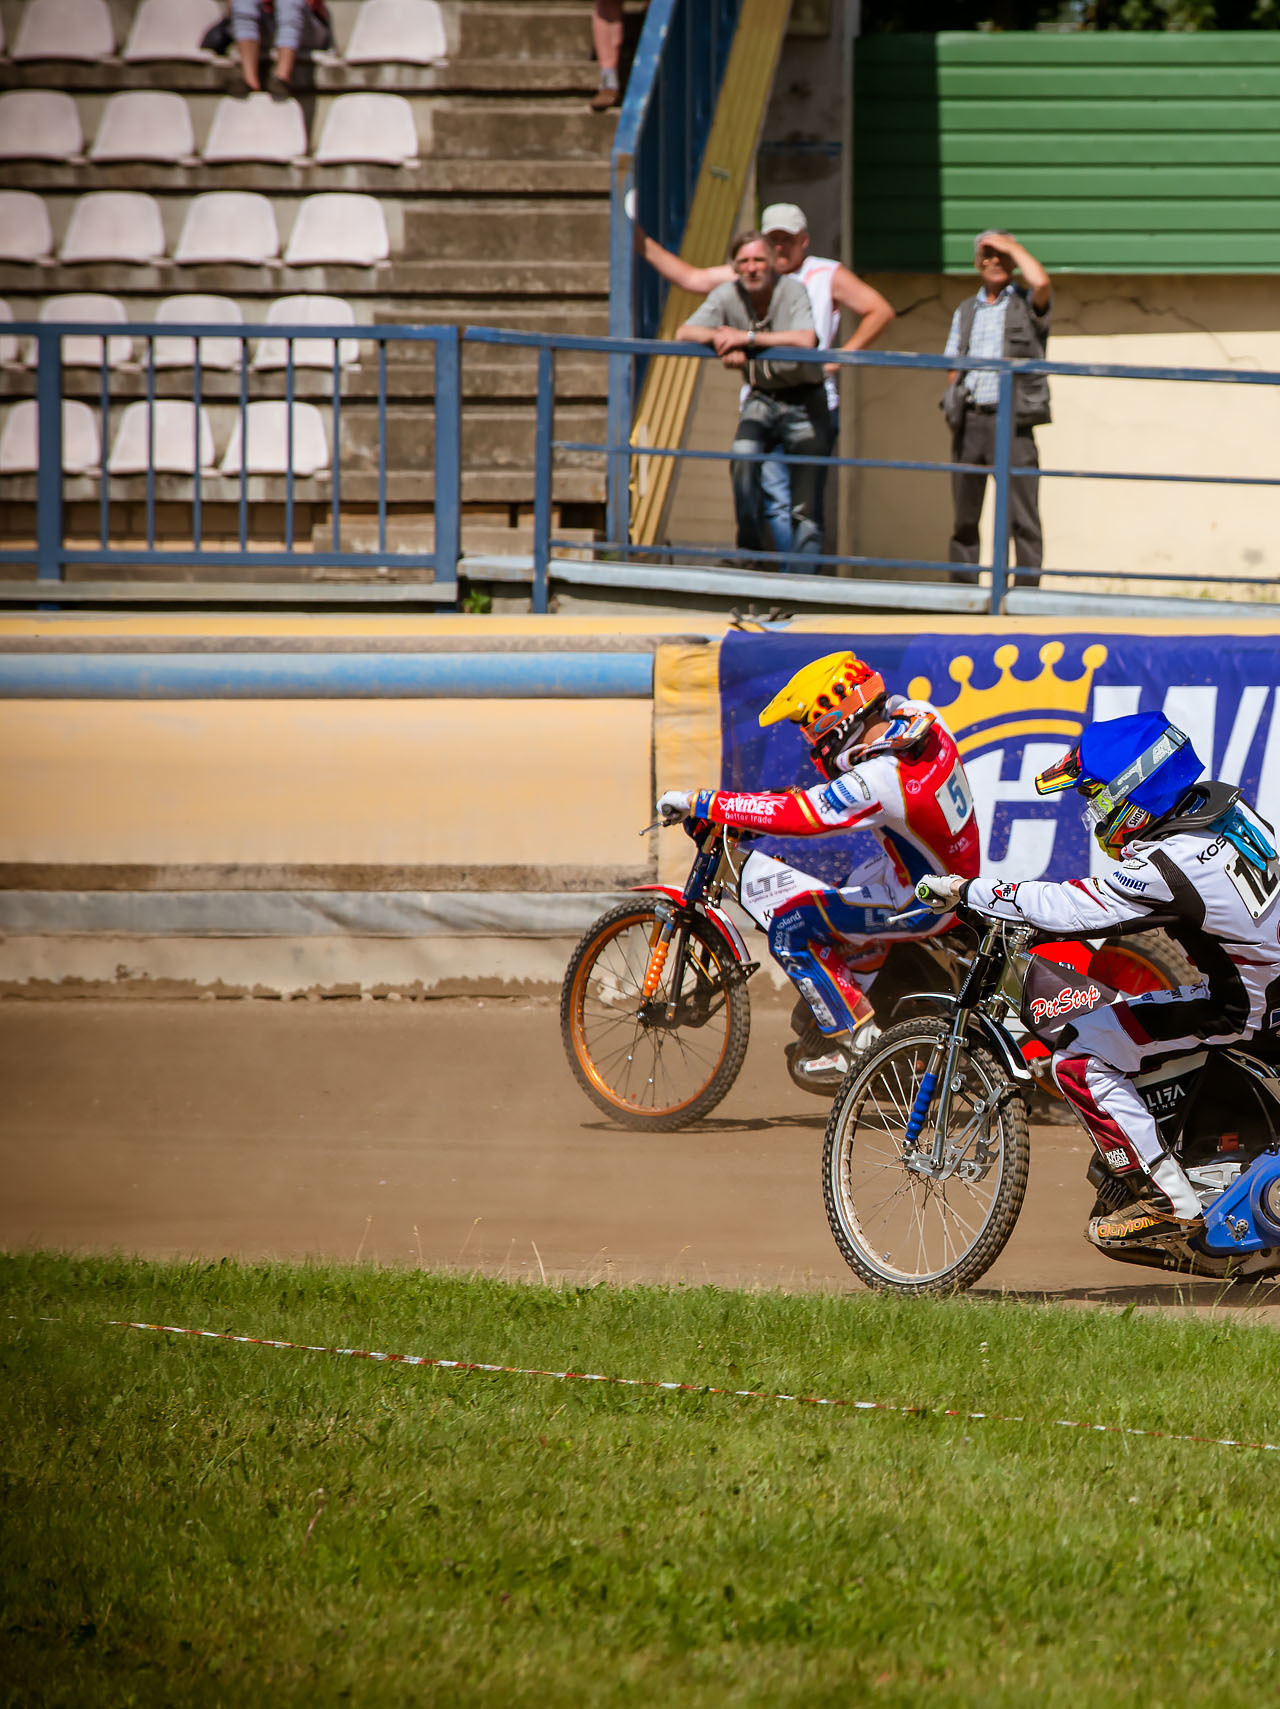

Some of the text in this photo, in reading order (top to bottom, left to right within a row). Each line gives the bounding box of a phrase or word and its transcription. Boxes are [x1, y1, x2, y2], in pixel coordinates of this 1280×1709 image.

[724, 796, 776, 815] AVIDES
[946, 773, 967, 819] 5
[746, 869, 795, 898] LTE
[1030, 985, 1101, 1024] PitStop
